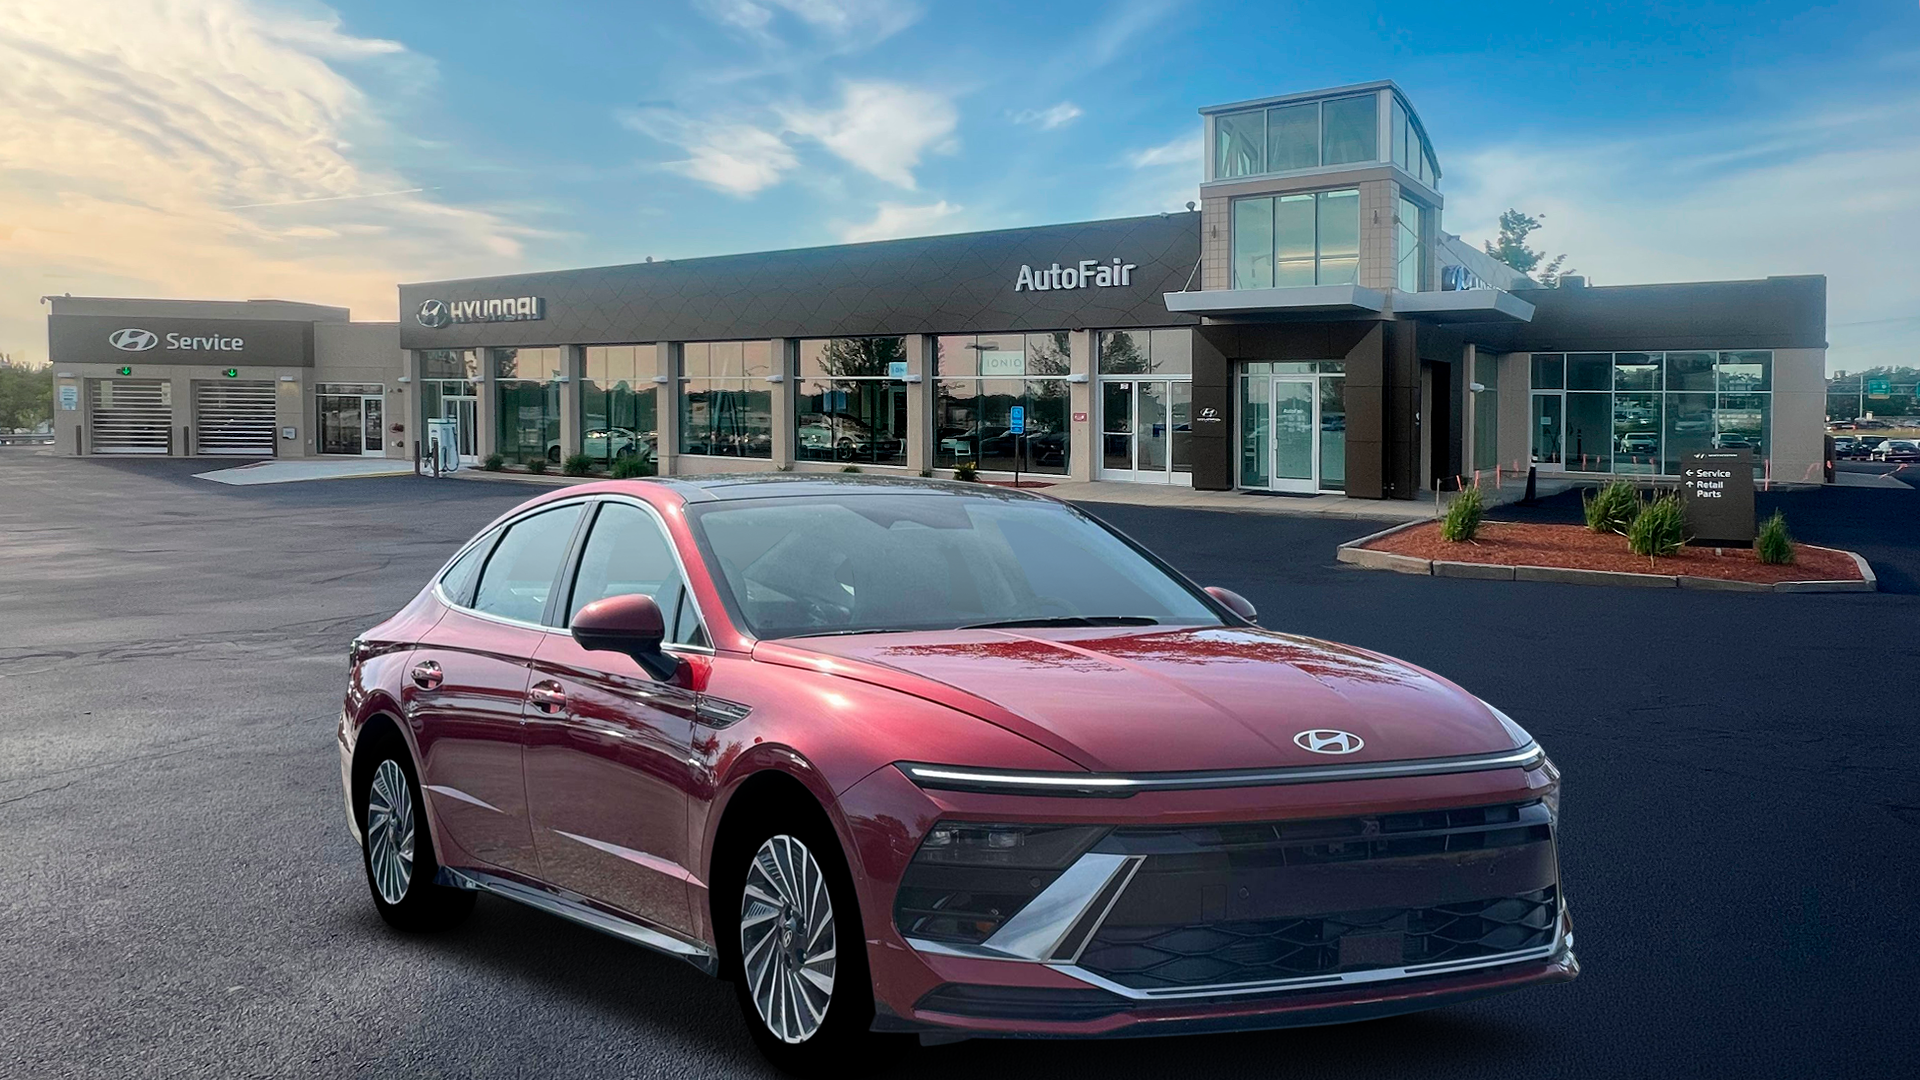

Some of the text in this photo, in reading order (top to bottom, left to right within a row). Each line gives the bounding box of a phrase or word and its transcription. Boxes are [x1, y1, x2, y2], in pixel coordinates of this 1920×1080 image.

[1015, 257, 1138, 292] AutoFair
[450, 296, 538, 322] HYUNDAI
[166, 332, 244, 351] Service
[1696, 469, 1731, 478] Service
[1696, 480, 1724, 489] Retail
[1696, 490, 1722, 499] Parts
